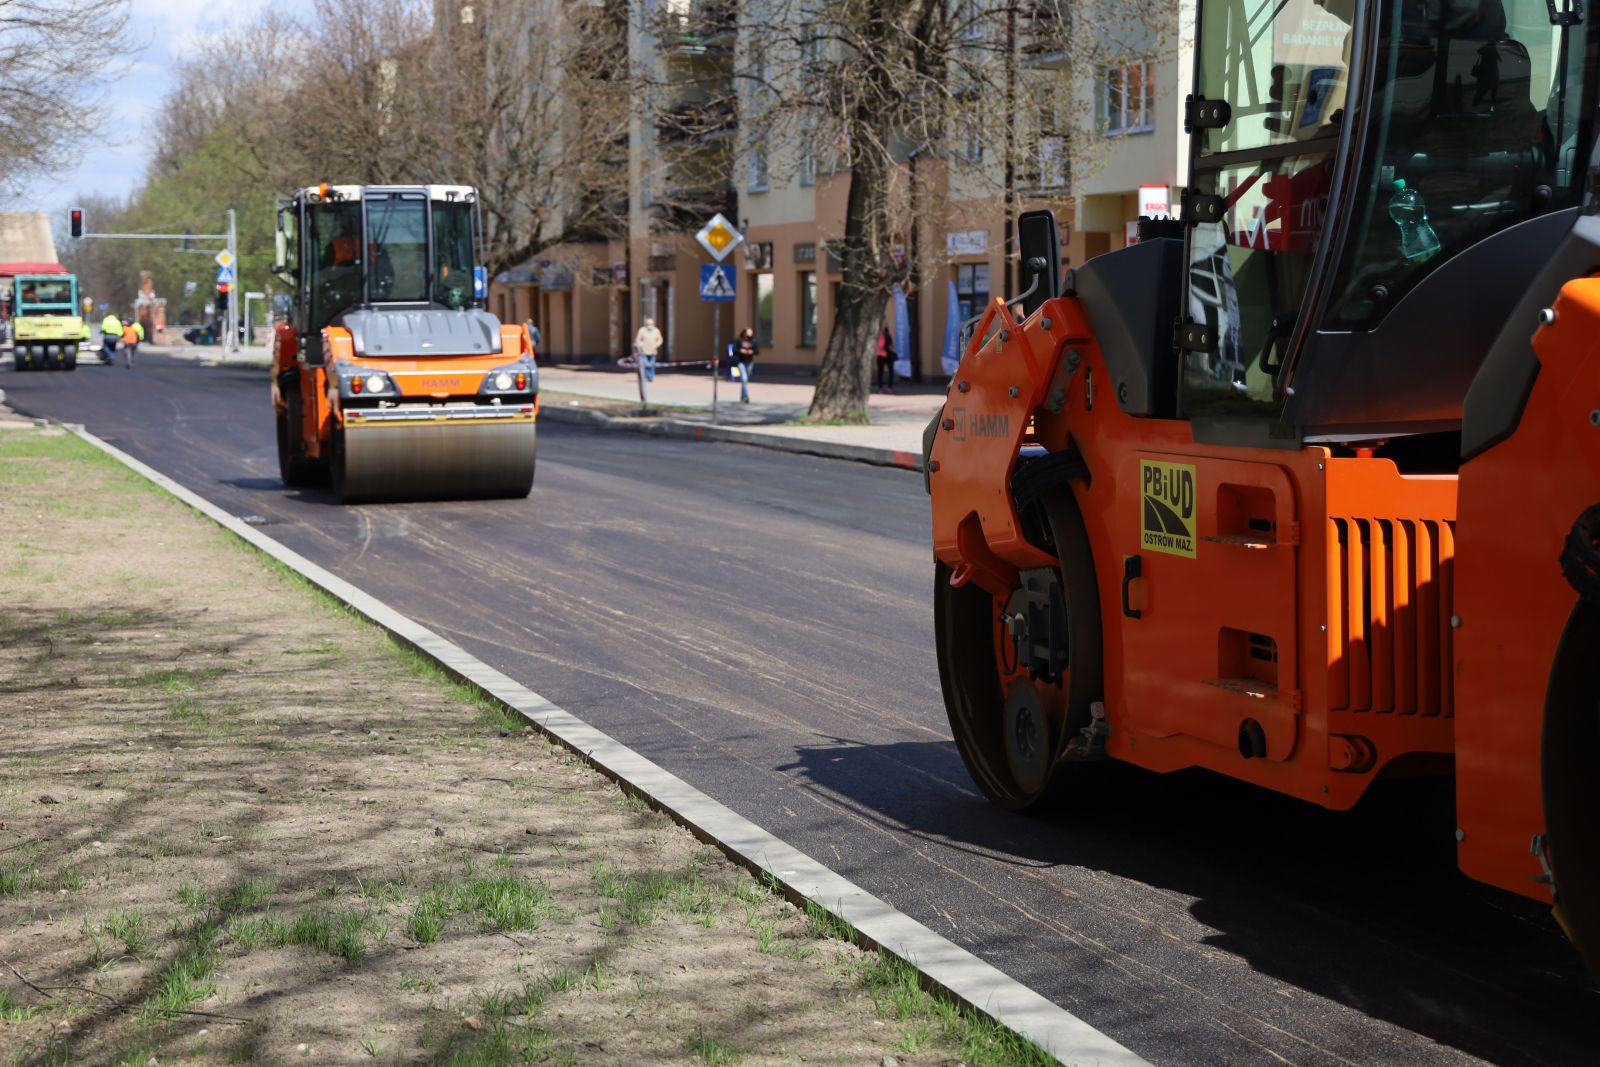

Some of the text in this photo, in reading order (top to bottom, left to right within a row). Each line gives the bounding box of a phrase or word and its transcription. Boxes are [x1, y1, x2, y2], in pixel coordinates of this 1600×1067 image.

[1282, 32, 1331, 47] BADANIE
[422, 378, 460, 388] HAMM
[969, 413, 1009, 438] HAMM
[1143, 465, 1194, 519] PBiUD
[1175, 538, 1193, 552] MAZ.
